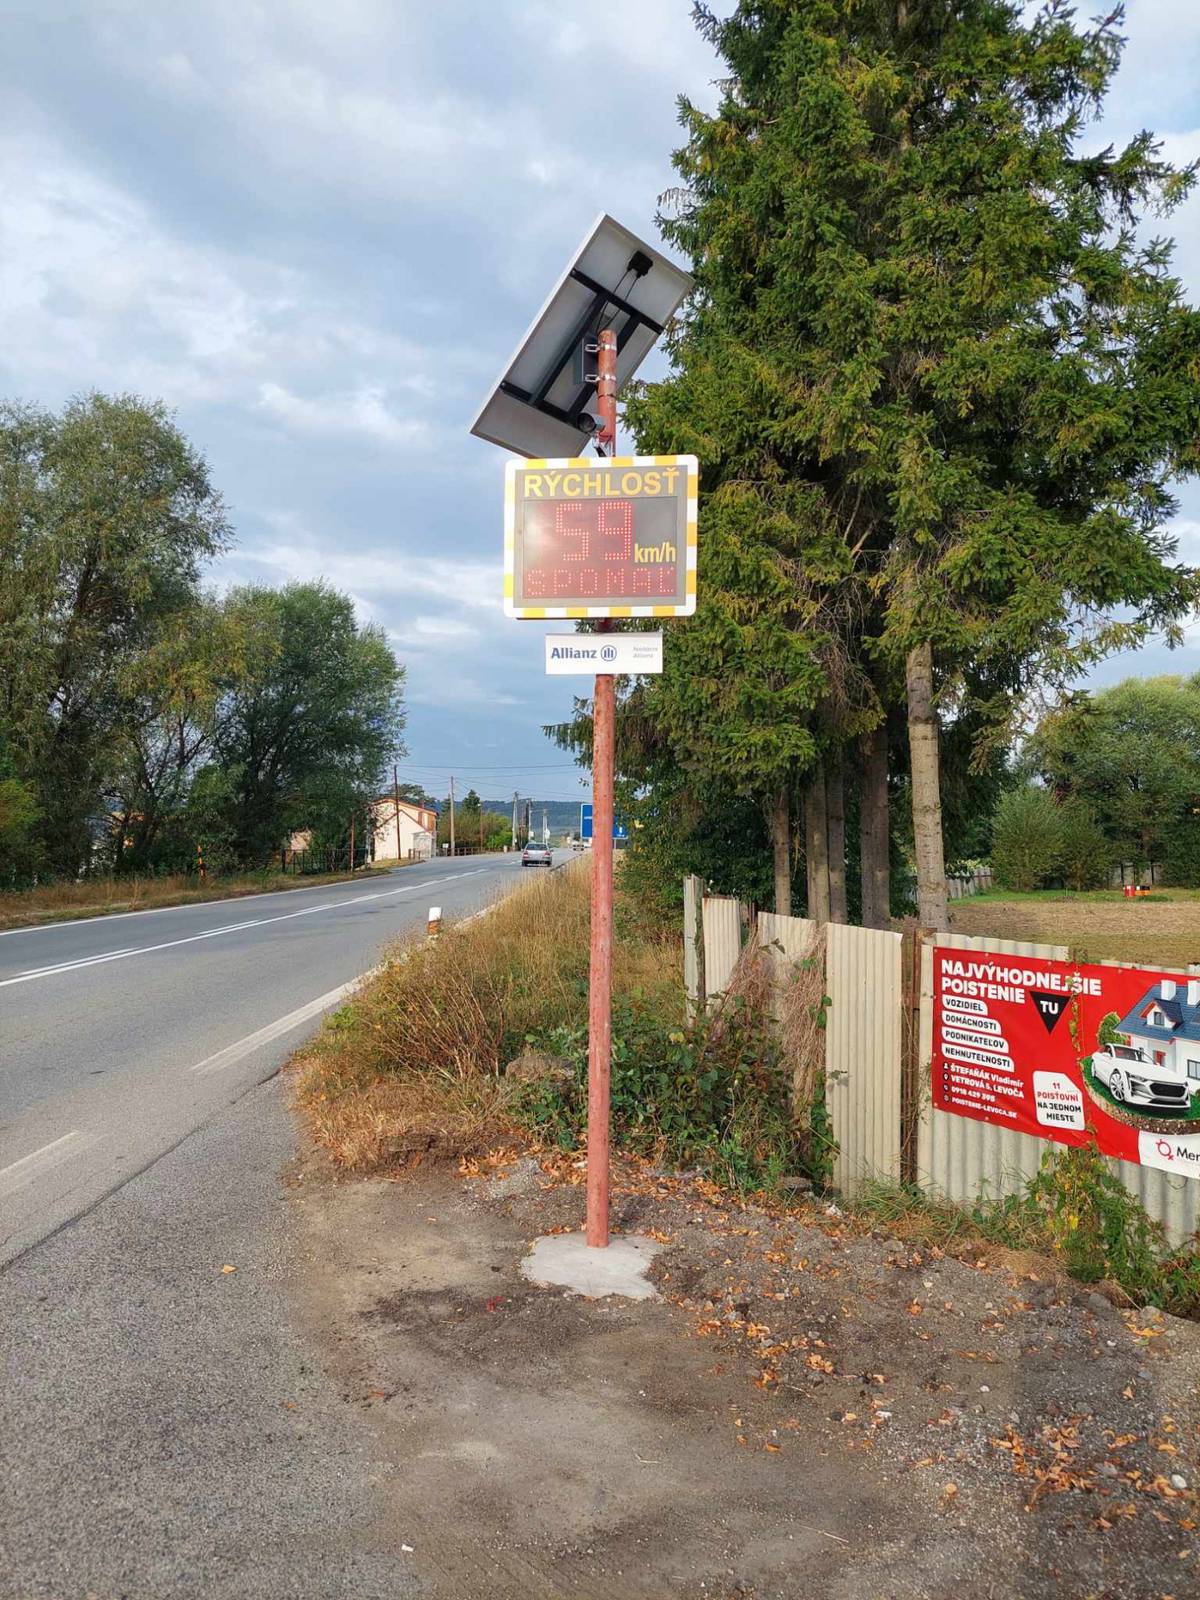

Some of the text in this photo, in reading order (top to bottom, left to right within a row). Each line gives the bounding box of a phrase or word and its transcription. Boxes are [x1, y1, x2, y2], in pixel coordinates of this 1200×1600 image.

[523, 467, 680, 497] RÝCHLOSŤ
[556, 501, 676, 563] 59 km/h
[551, 647, 597, 659] Allianz
[941, 959, 1102, 996] NAJVÝHODNEJŠIE
[941, 977, 1025, 1004] POISTENIE
[945, 998, 983, 1012] VOZIDIEL
[1040, 1000, 1059, 1014] TU
[945, 1013, 997, 1031] DOMÁCNOSTI
[945, 1031, 1005, 1049] PODNIKATEĽOV
[993, 1084, 1025, 1098] LEVOČA
[1037, 1101, 1081, 1112] NA JEDNOM
[1046, 1113, 1075, 1122] MIESTE
